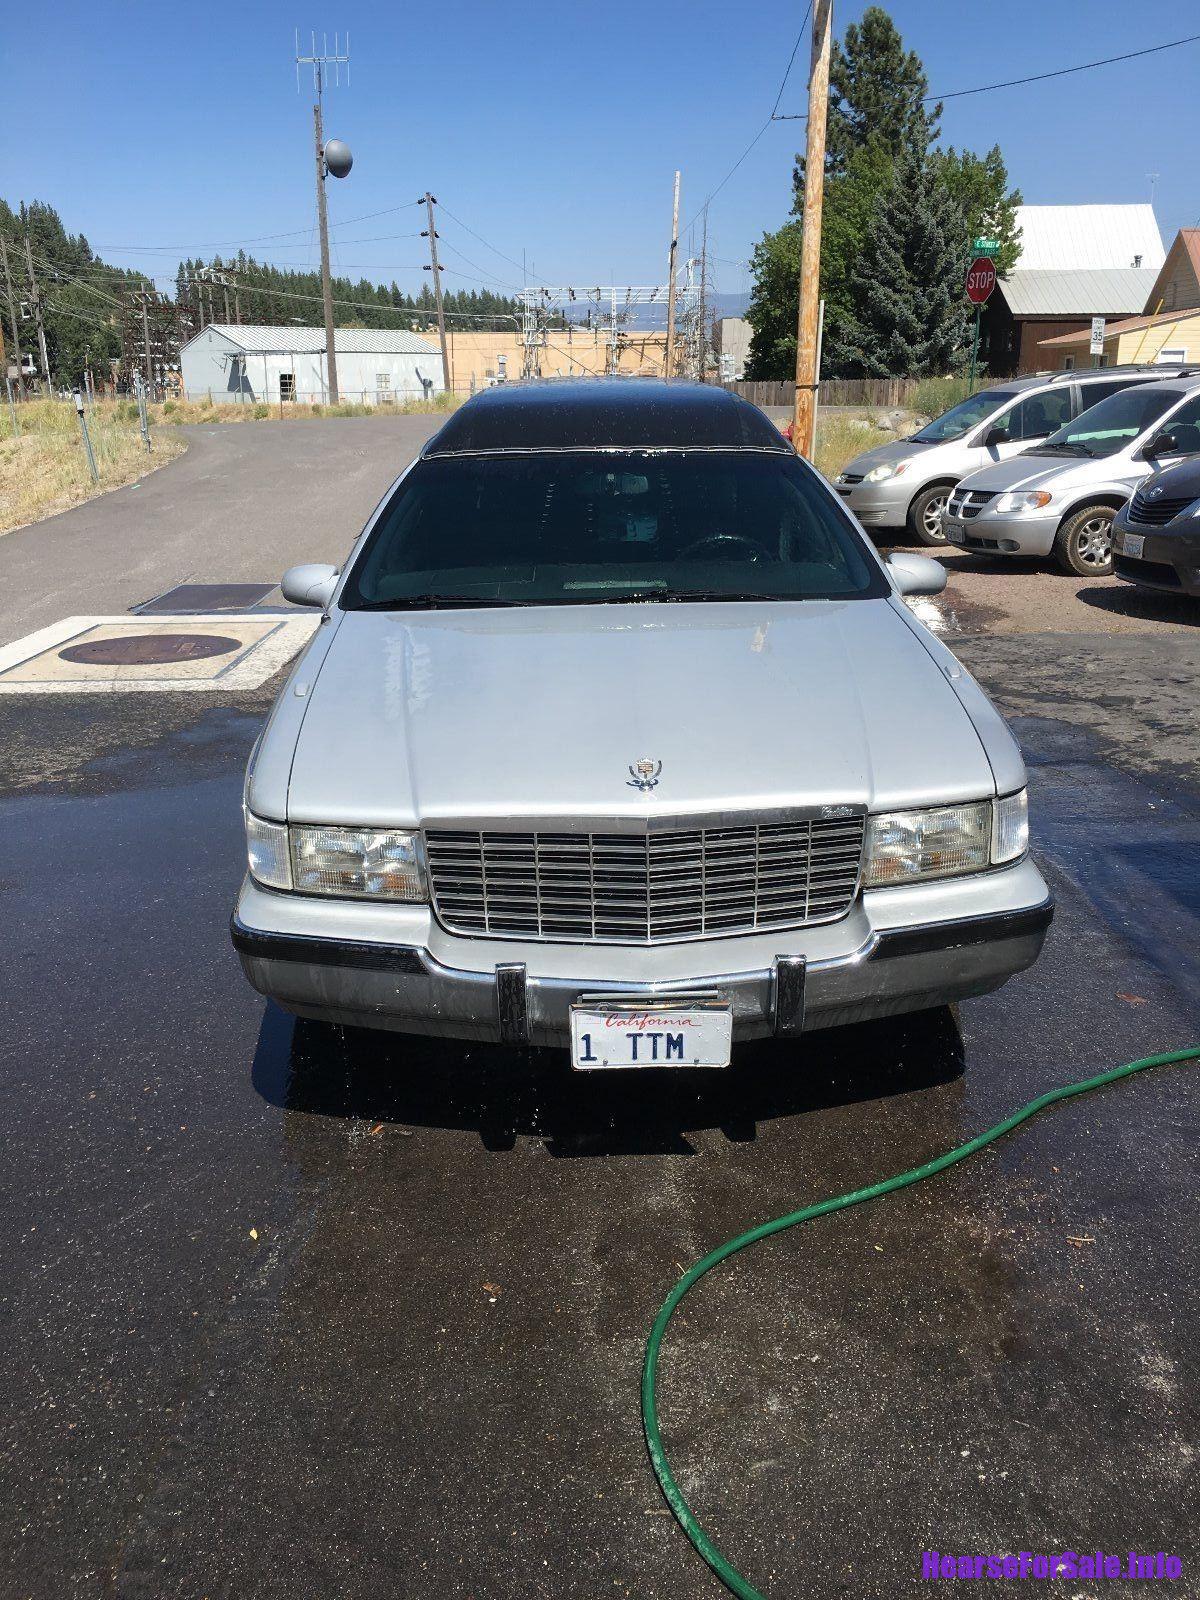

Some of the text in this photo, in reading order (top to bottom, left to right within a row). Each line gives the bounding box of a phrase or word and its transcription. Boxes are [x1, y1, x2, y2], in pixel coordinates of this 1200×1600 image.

[968, 272, 994, 290] STOP
[1092, 331, 1103, 341] 35
[605, 1013, 702, 1031] California
[580, 1032, 684, 1061] 1 TTM
